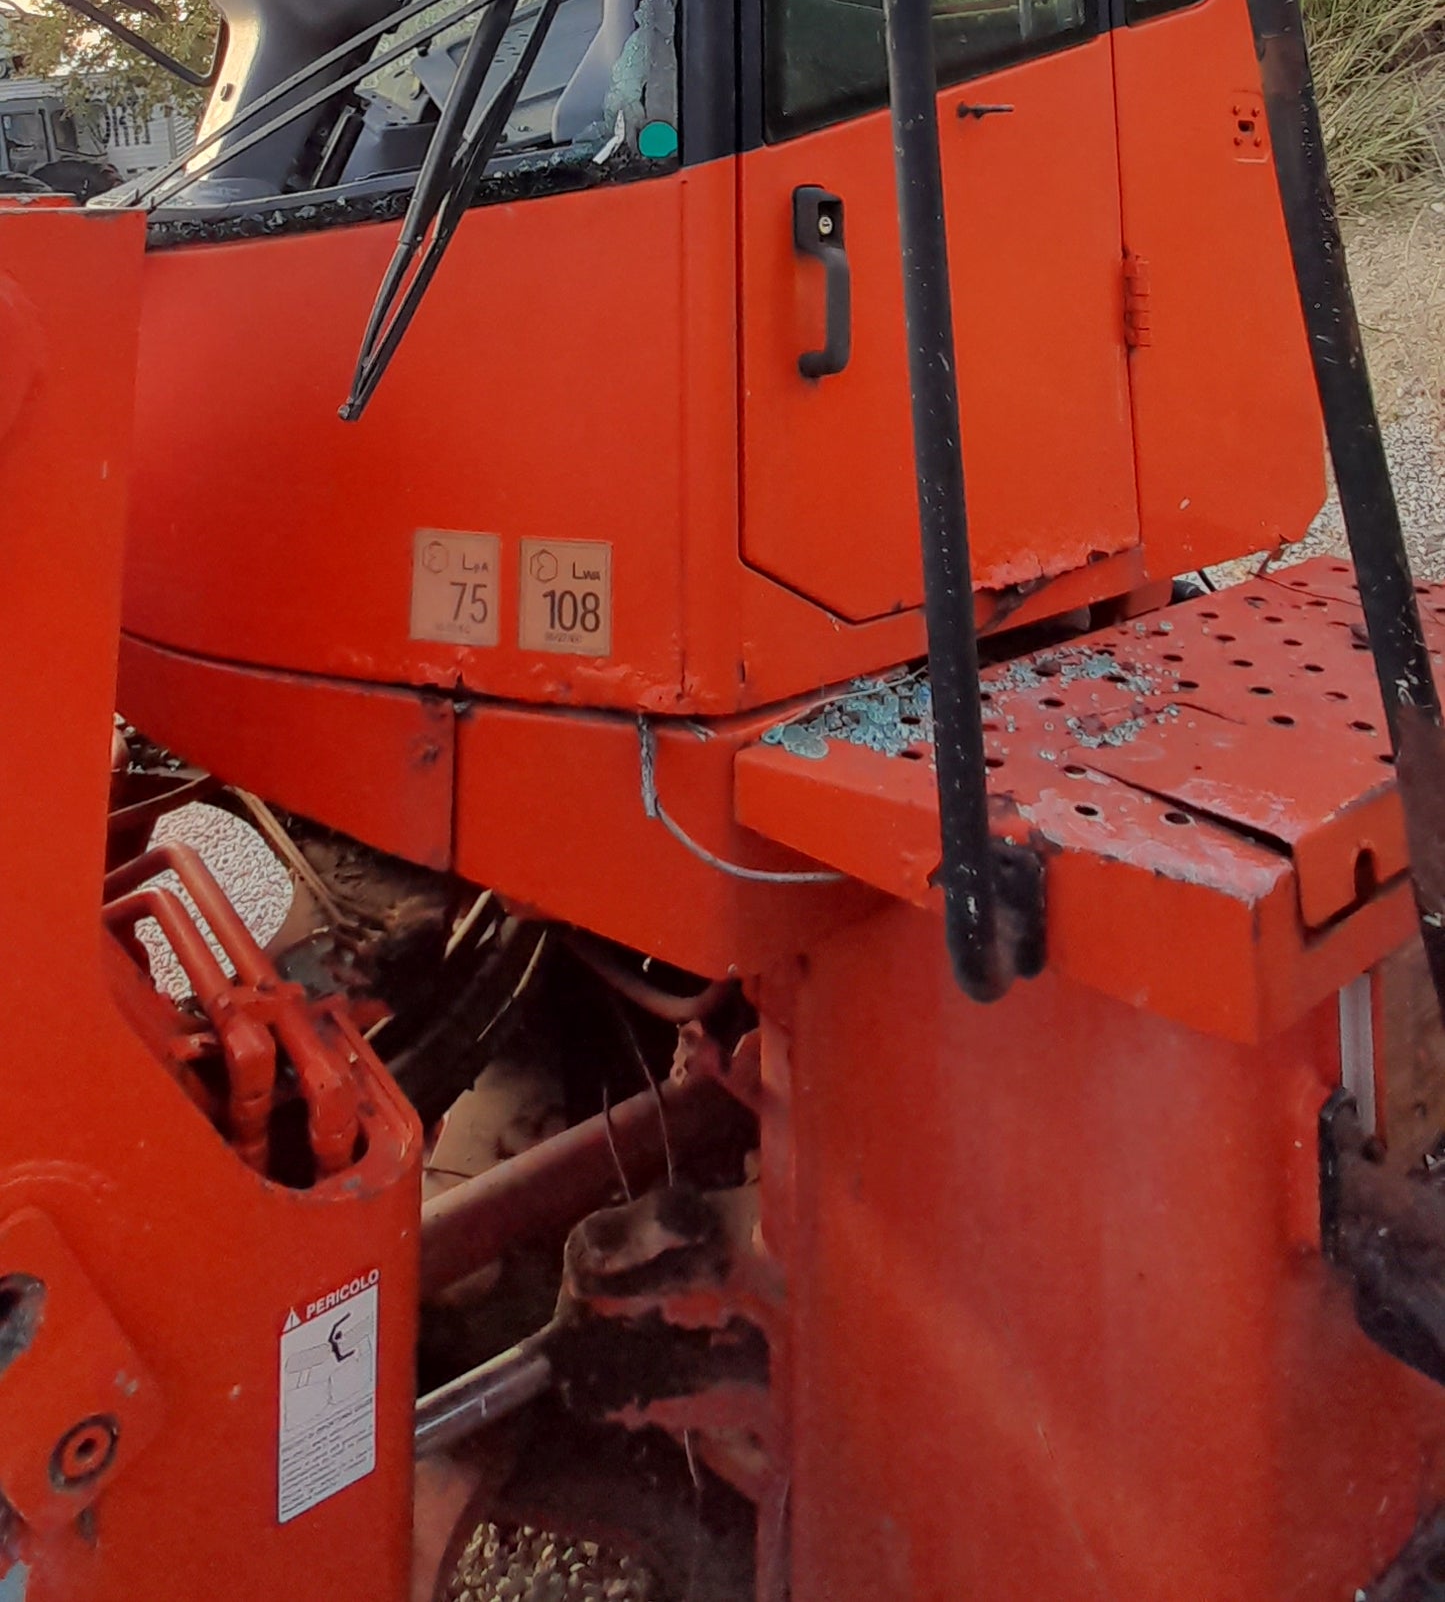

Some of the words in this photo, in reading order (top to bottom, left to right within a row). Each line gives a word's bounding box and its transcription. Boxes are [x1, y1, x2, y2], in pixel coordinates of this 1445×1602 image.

[449, 581, 488, 624] 75
[541, 588, 601, 633] 108
[305, 1268, 380, 1320] PERICOLO
